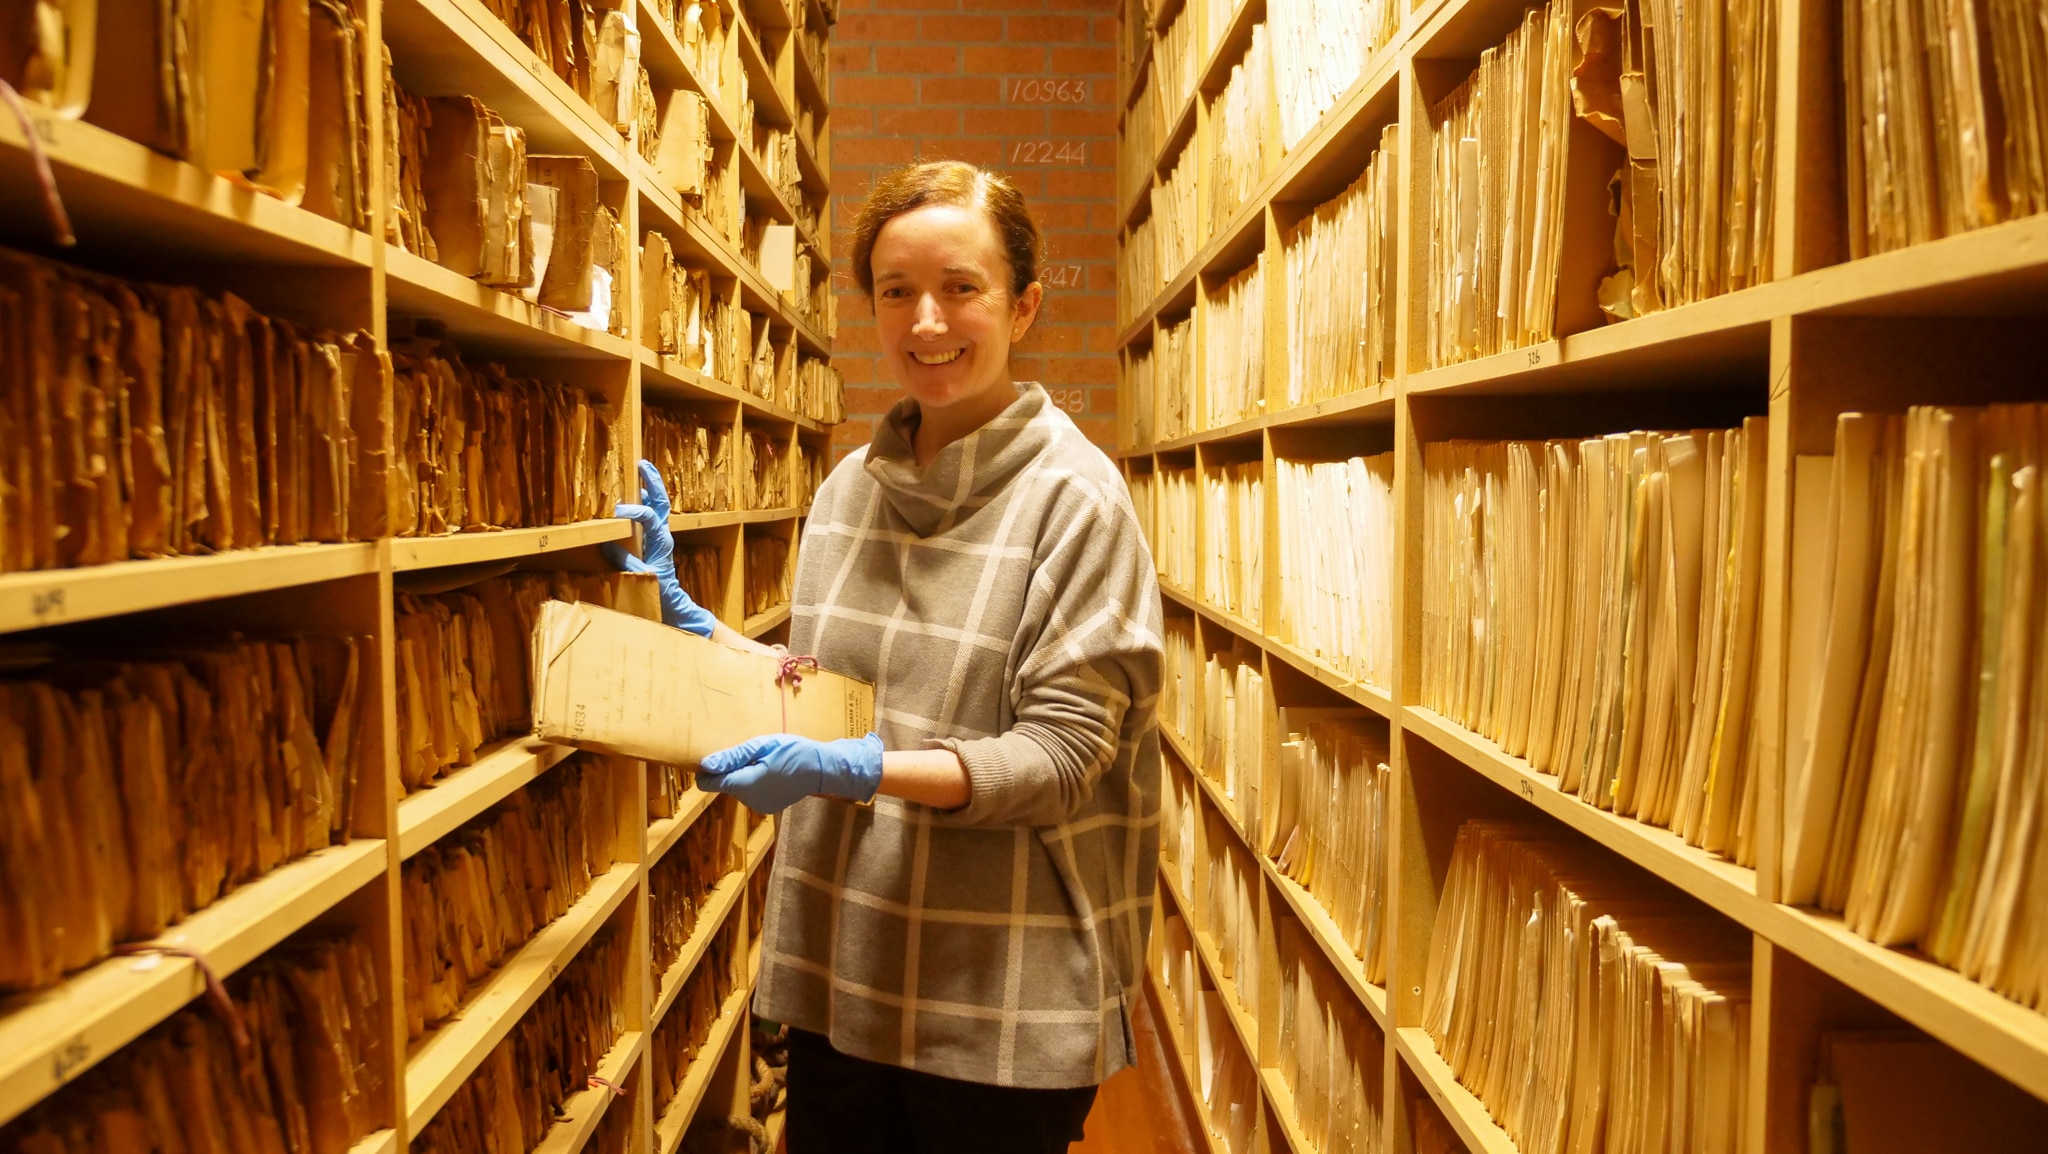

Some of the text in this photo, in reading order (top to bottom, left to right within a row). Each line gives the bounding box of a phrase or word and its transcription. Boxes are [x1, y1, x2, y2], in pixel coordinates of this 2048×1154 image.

[1011, 79, 1085, 104] 10963
[1011, 140, 1086, 167] 12244
[1527, 348, 1541, 369] 326
